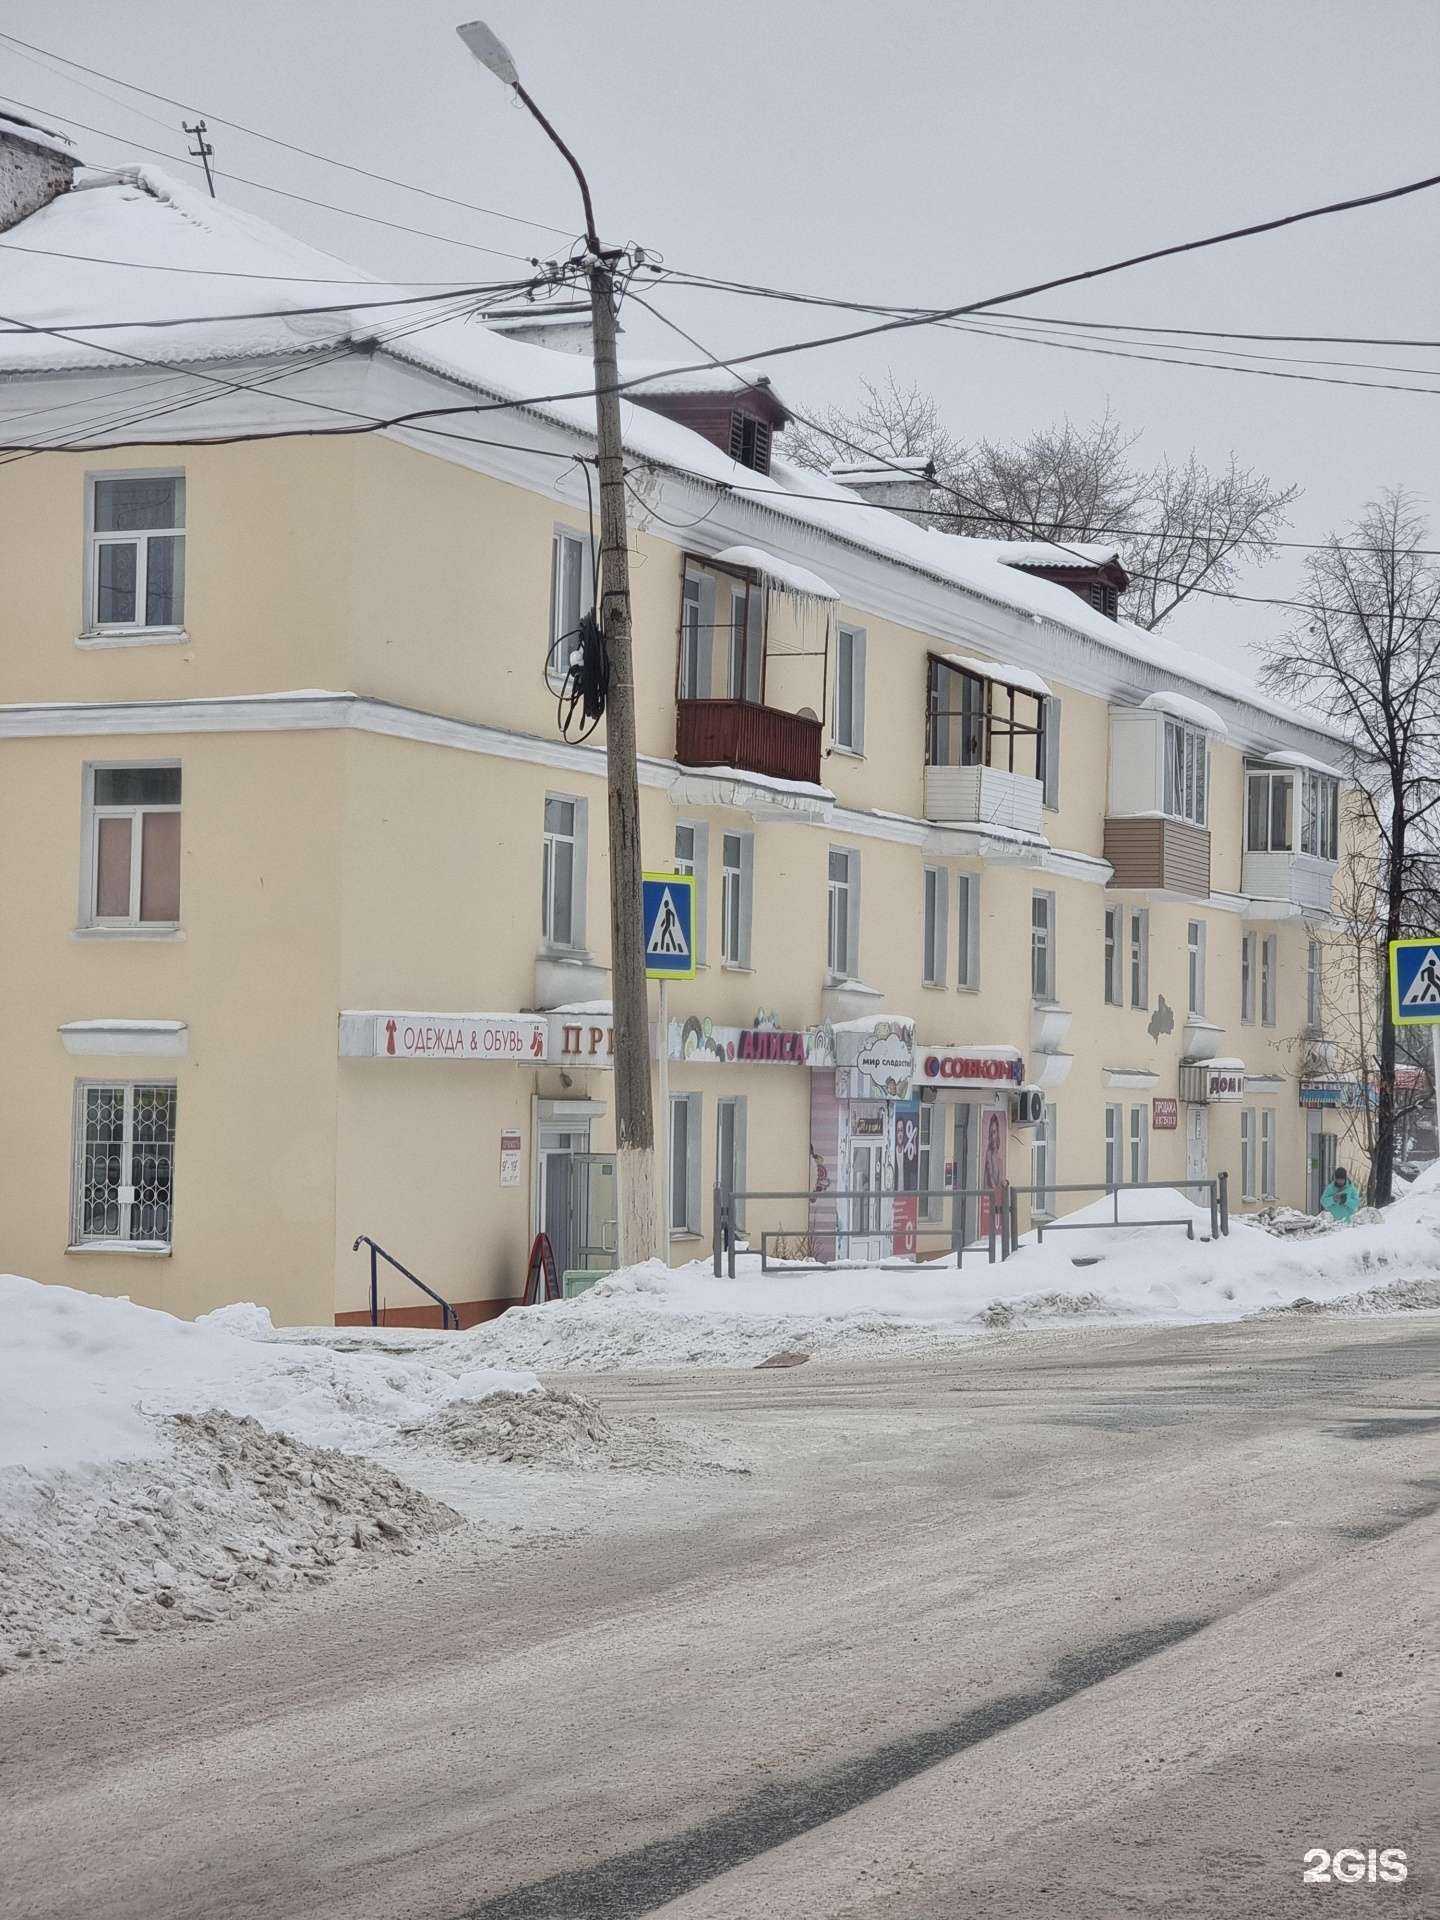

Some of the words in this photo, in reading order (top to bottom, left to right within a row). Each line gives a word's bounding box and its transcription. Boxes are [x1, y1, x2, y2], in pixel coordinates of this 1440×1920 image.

[403, 1027, 464, 1054] ОДЕЖДА
[470, 1031, 478, 1050] &
[483, 1029, 523, 1052] ОБУВЬ
[738, 1030, 804, 1065] АЛИСА
[863, 1058, 880, 1068] мир
